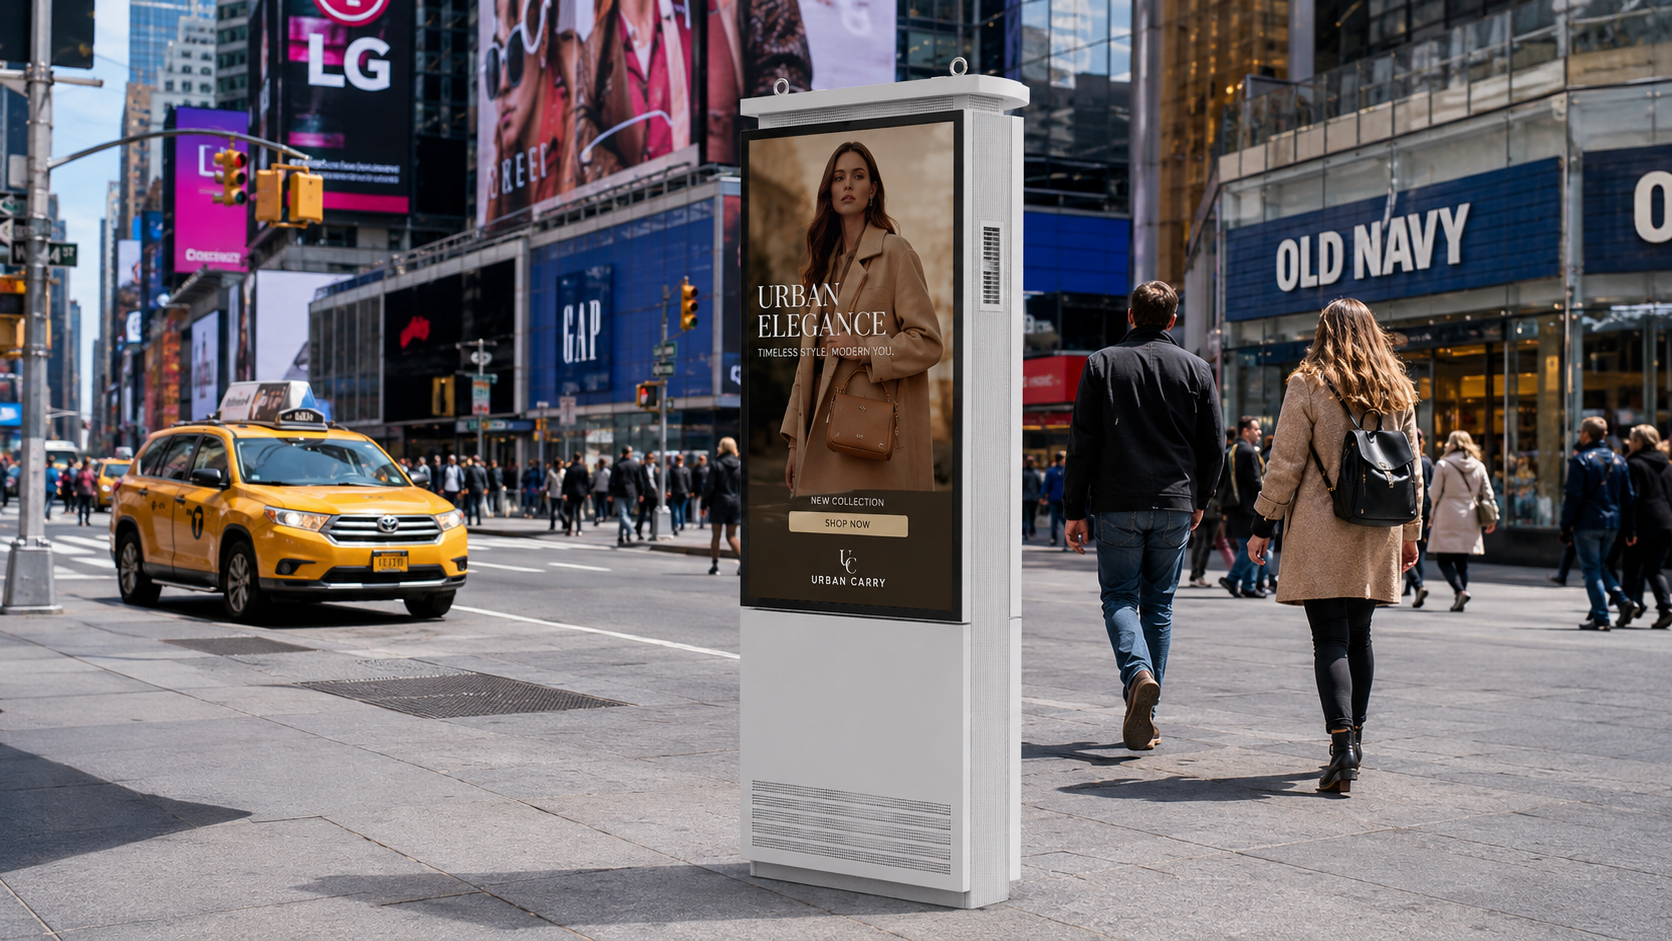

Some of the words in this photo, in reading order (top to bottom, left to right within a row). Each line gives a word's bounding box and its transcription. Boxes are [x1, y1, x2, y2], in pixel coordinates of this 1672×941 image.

[308, 32, 391, 92] LG
[1634, 170, 1672, 243] O
[1276, 230, 1345, 292] OLD
[1354, 202, 1471, 280] NAVY
[757, 282, 840, 309] URBAN
[563, 299, 602, 364] GAP
[757, 311, 887, 338] ELEGANCE
[758, 348, 798, 357] TIMELESS
[831, 346, 871, 357] MODERN
[872, 346, 895, 356] YOU.
[832, 497, 884, 506] COLLECTION
[825, 518, 848, 528] SHOP
[850, 519, 871, 529] NOW
[811, 575, 846, 585] URBAN
[850, 577, 885, 587] CARRY
